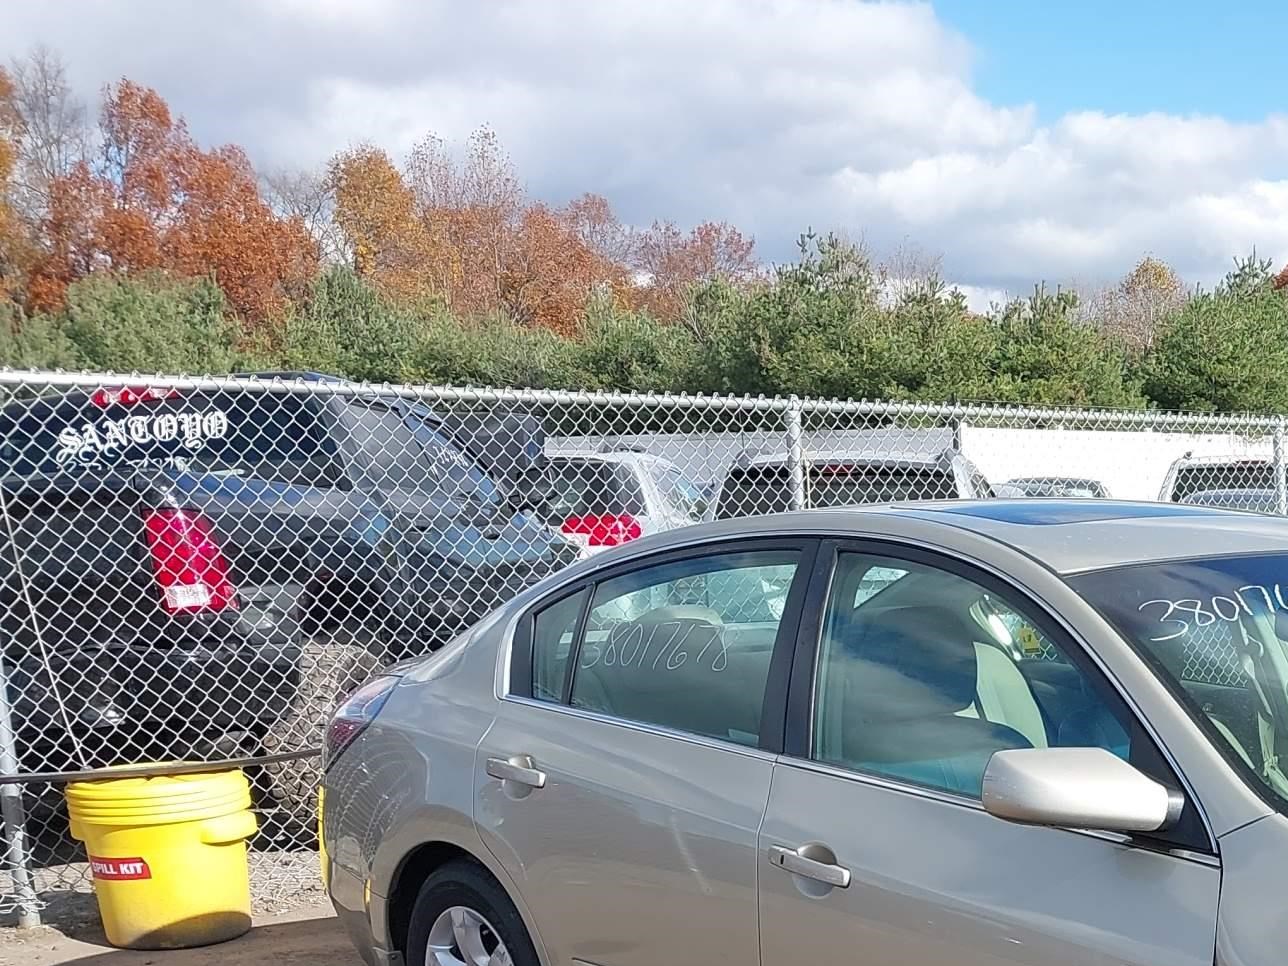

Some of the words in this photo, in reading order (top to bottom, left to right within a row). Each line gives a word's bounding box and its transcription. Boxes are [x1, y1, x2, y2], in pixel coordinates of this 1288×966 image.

[56, 410, 229, 463] SANTOYO
[91, 862, 118, 875] SPILL
[119, 862, 144, 875] KIT
